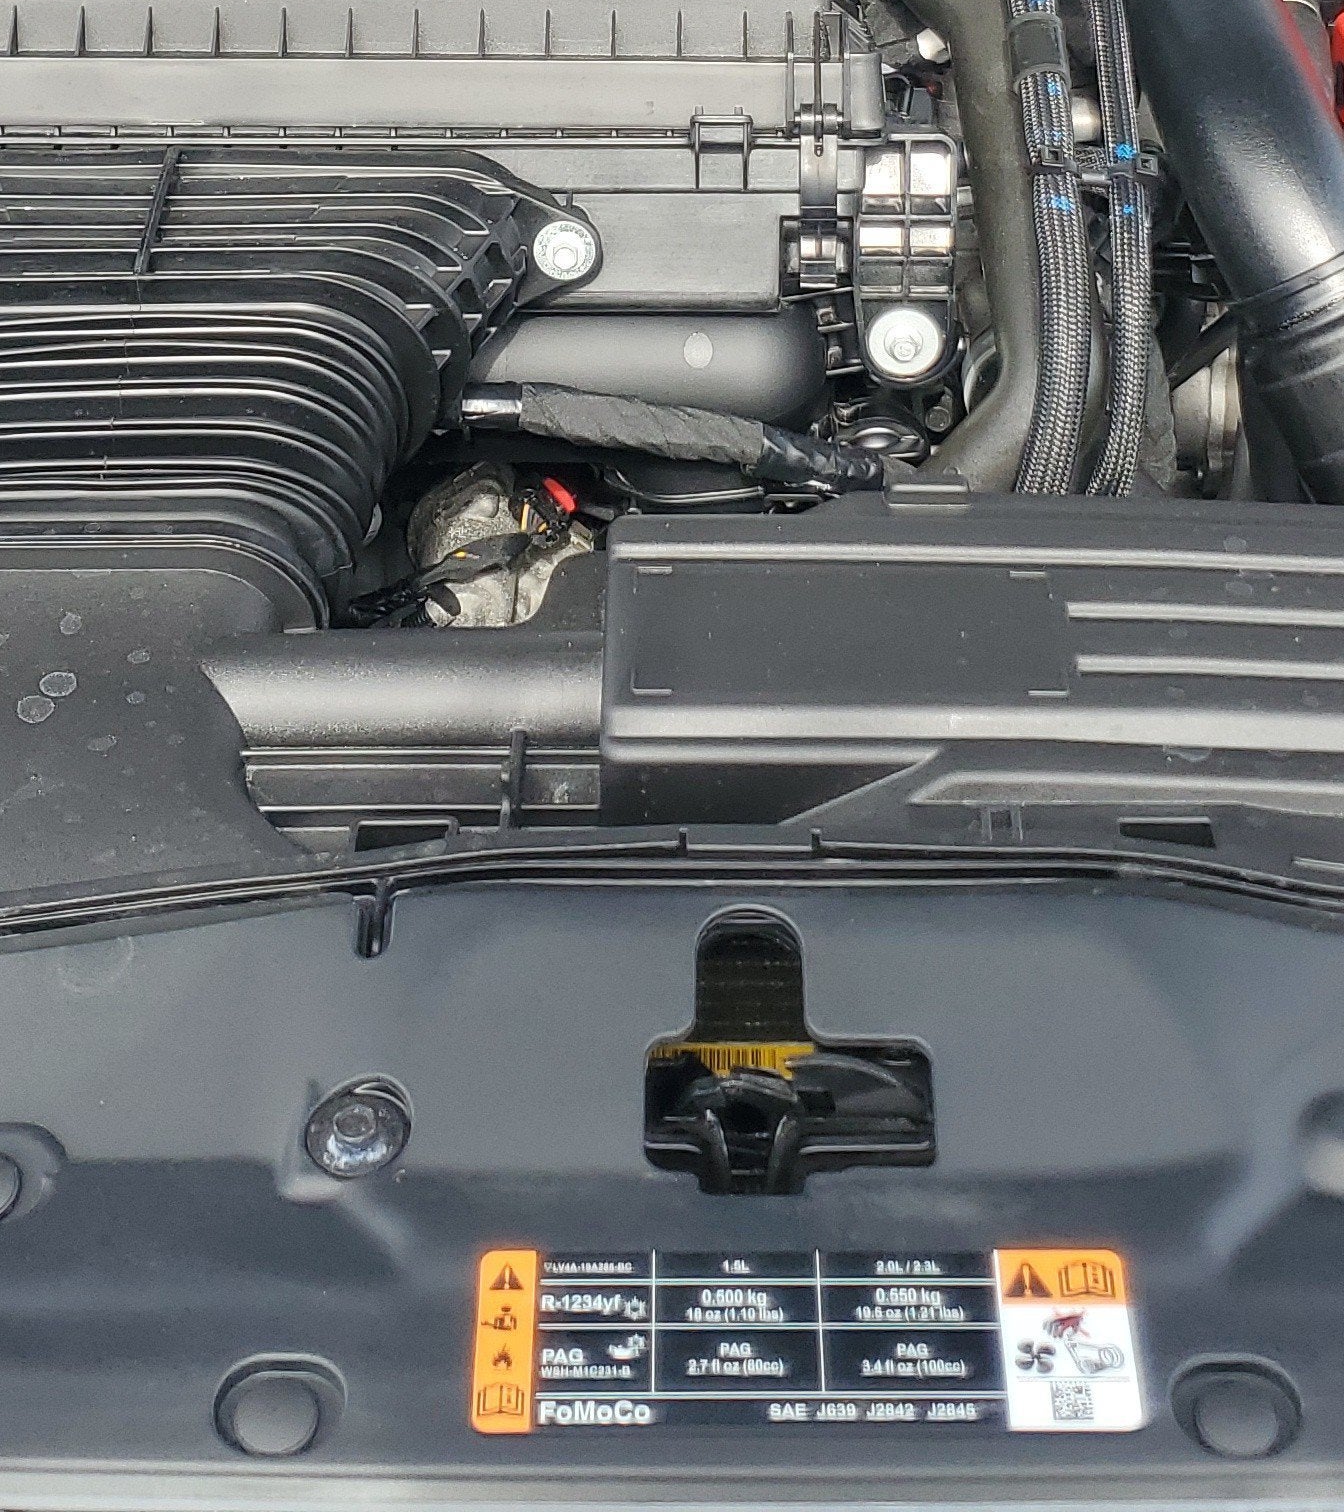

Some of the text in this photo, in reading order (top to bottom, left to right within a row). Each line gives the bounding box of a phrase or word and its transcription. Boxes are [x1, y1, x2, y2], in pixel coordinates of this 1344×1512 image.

[541, 1293, 622, 1315] R-1234yf
[747, 1288, 767, 1307] kg
[921, 1287, 940, 1306] kg
[706, 1309, 721, 1321] oz
[759, 1306, 784, 1322] lbs)
[886, 1308, 902, 1320] oz
[542, 1348, 584, 1365] PAG
[720, 1342, 752, 1357] PAG
[896, 1343, 929, 1358] PAG
[688, 1358, 708, 1374] 2.7
[723, 1361, 739, 1374] oz
[862, 1359, 882, 1374] 3.4
[897, 1362, 913, 1374] oz
[917, 1358, 965, 1376] (100cc)
[540, 1400, 650, 1424] FoMoCo
[770, 1402, 806, 1418] SAE
[817, 1402, 856, 1418] J639
[865, 1402, 914, 1418] J2842
